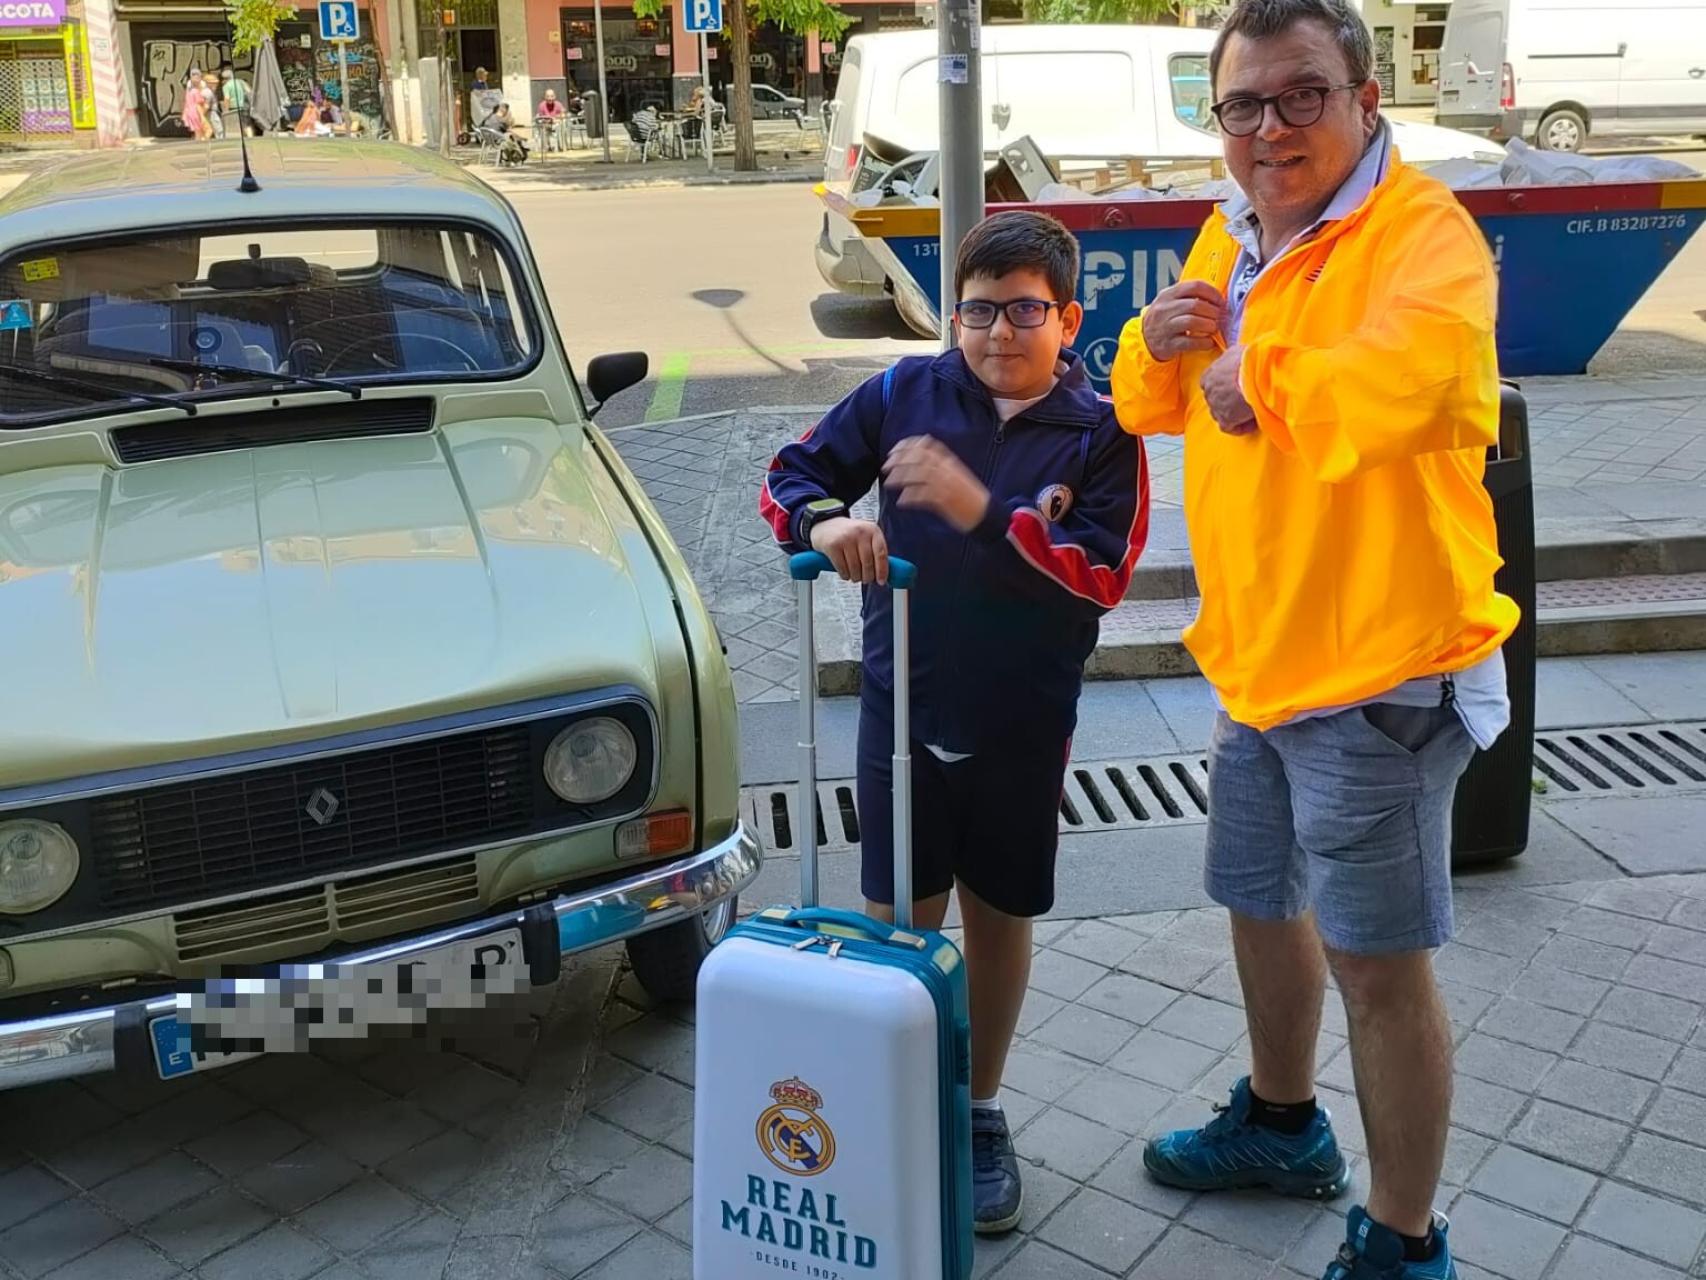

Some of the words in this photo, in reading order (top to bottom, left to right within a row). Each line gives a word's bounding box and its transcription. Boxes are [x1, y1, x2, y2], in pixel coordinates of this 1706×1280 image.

[0, 3, 55, 18] COTA
[329, 4, 347, 35] P
[694, 0, 711, 28] P
[1566, 219, 1594, 234] CIF.
[1597, 218, 1608, 232] B
[747, 1174, 846, 1228] REAL
[721, 1199, 877, 1269] MADRID
[756, 1251, 798, 1271] DESDE
